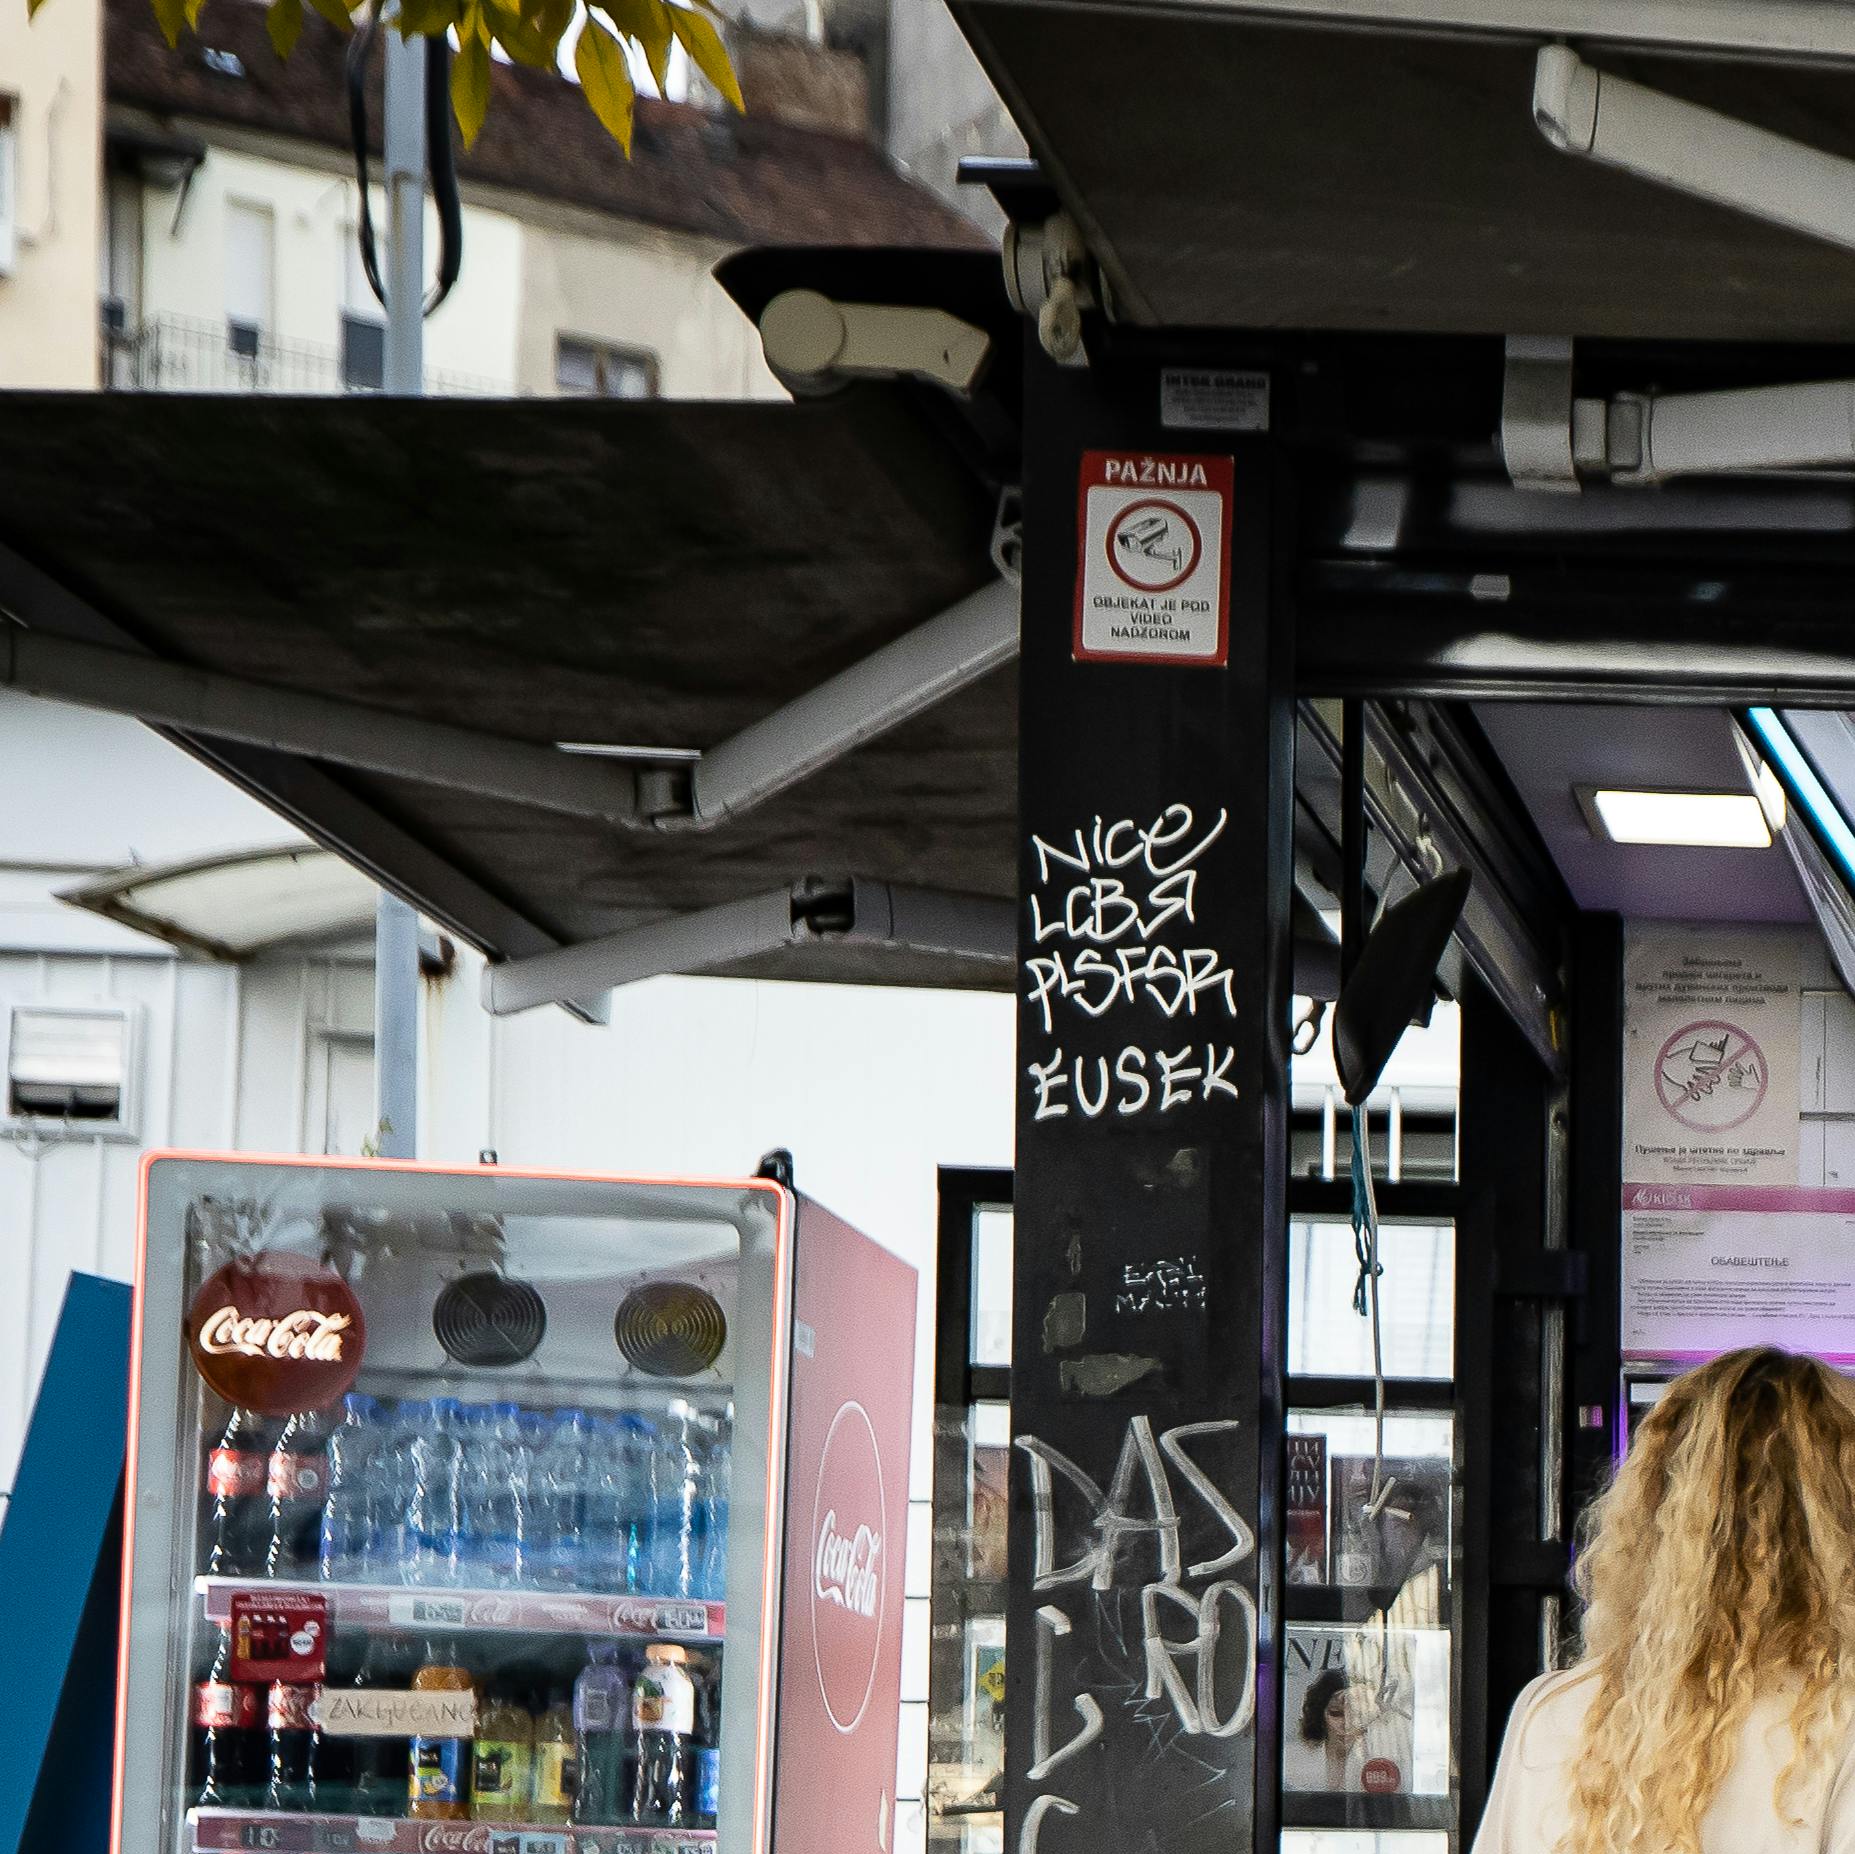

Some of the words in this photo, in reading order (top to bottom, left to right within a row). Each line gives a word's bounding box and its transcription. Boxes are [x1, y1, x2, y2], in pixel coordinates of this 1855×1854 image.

[1105, 457, 1208, 486] PAŽNJA
[1093, 596, 1155, 610] OBJEKAT
[1161, 600, 1176, 611] JE
[1182, 600, 1210, 612] POD
[1130, 613, 1172, 624] VIDEO
[1110, 626, 1191, 641] NADZOROM
[1710, 1256, 1789, 1268] ОБАВЕШТЕЊЕ
